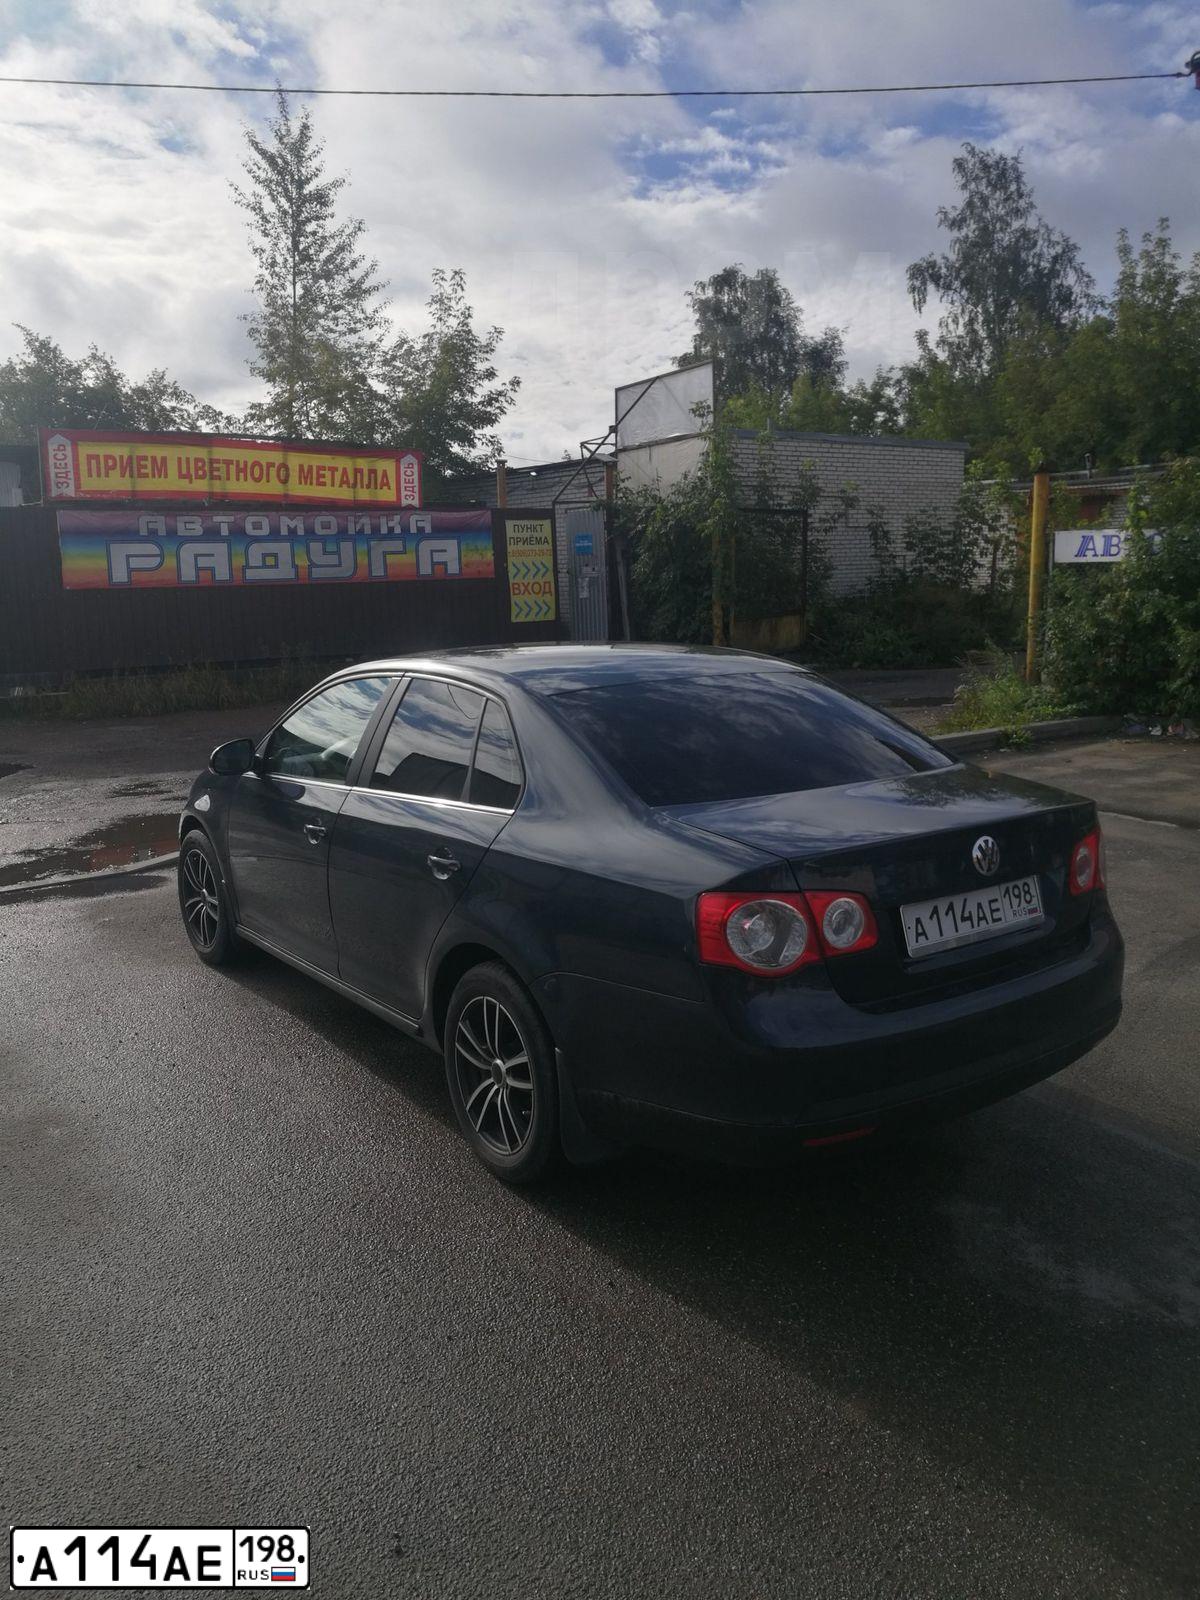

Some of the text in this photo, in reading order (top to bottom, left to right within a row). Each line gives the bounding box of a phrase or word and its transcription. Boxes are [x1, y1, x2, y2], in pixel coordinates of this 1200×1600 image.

[53, 443, 71, 490] ЗДЕСЬ
[86, 453, 392, 491] ПРИЕМ ЦВЕТНОГО МЕТАЛЛА
[403, 461, 416, 502] ЗДЕСЬ
[138, 513, 433, 537] АВТОМОЙКА
[508, 534, 550, 547] ПРИЁМА
[513, 523, 545, 534] ПУНКТ
[107, 538, 462, 584] РАДУГА
[511, 581, 553, 597] ВХОД
[914, 881, 1034, 944] А114АЕ 198
[1012, 907, 1028, 919] RUS
